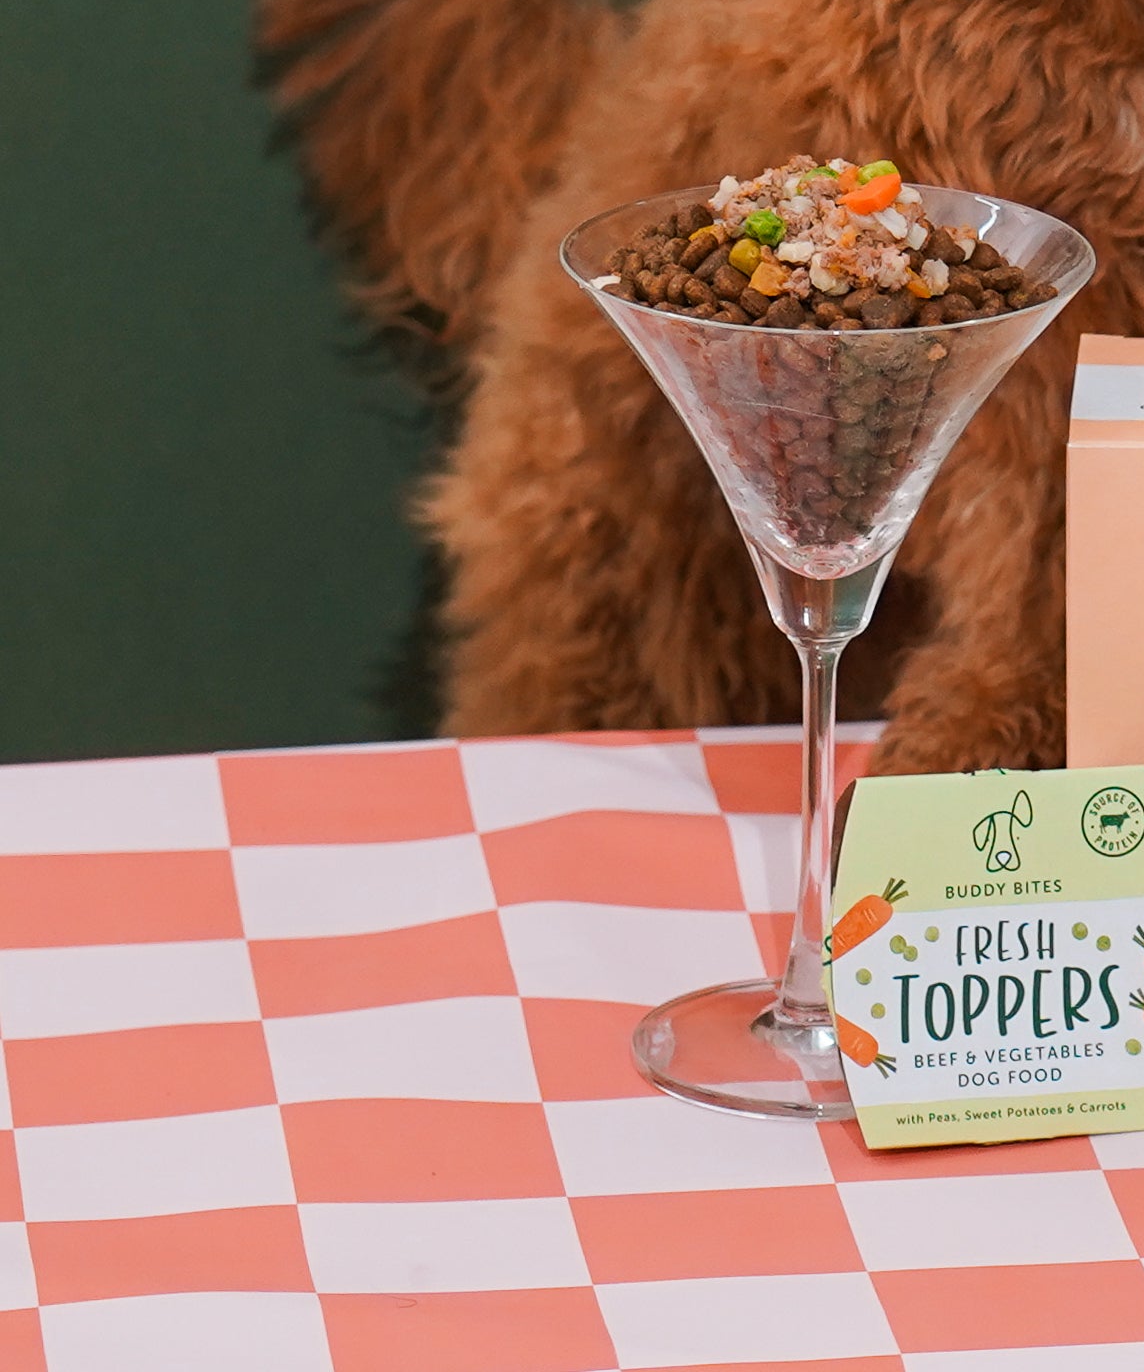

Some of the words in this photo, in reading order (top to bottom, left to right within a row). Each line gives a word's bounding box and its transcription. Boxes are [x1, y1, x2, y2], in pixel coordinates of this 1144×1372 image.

[1089, 793, 1125, 816] SOURCE
[1127, 801, 1140, 815] OF
[1094, 830, 1139, 851] PROTEIN
[945, 883, 1005, 899] BUDDY
[1013, 879, 1062, 895] BITES
[956, 919, 1054, 966] FRESH
[892, 964, 1120, 1044] TOPPERS
[914, 1052, 958, 1069] BEEF
[966, 1051, 976, 1065] &
[984, 1042, 1105, 1064] VEGETABLES
[958, 1072, 1000, 1087] DOG
[1009, 1068, 1062, 1084] FOOD
[896, 1114, 924, 1126] with
[964, 1109, 1002, 1121] Sweet
[1007, 1105, 1063, 1118] Potatoes
[1066, 1103, 1075, 1114] &
[1079, 1101, 1126, 1113] Carrots
